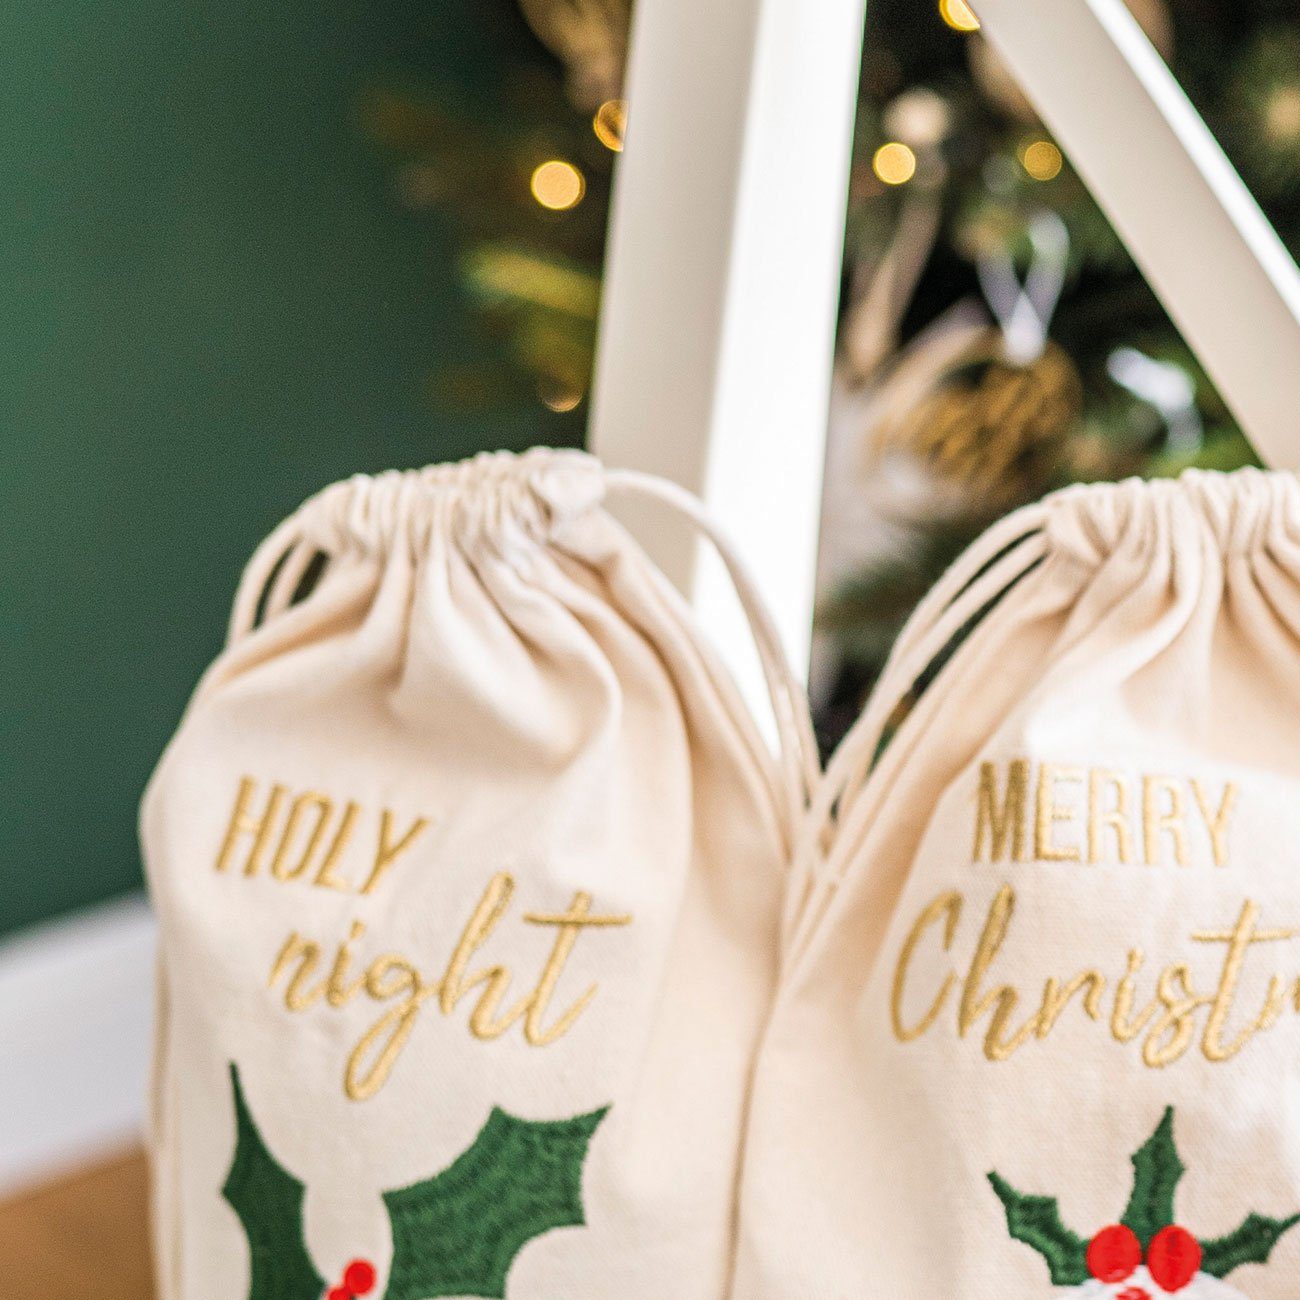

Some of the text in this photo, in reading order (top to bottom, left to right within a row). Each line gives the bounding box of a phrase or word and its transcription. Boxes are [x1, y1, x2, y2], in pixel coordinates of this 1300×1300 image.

[213, 774, 431, 895] HOLY
[972, 759, 1240, 867] MERRY
[266, 871, 634, 1102] night
